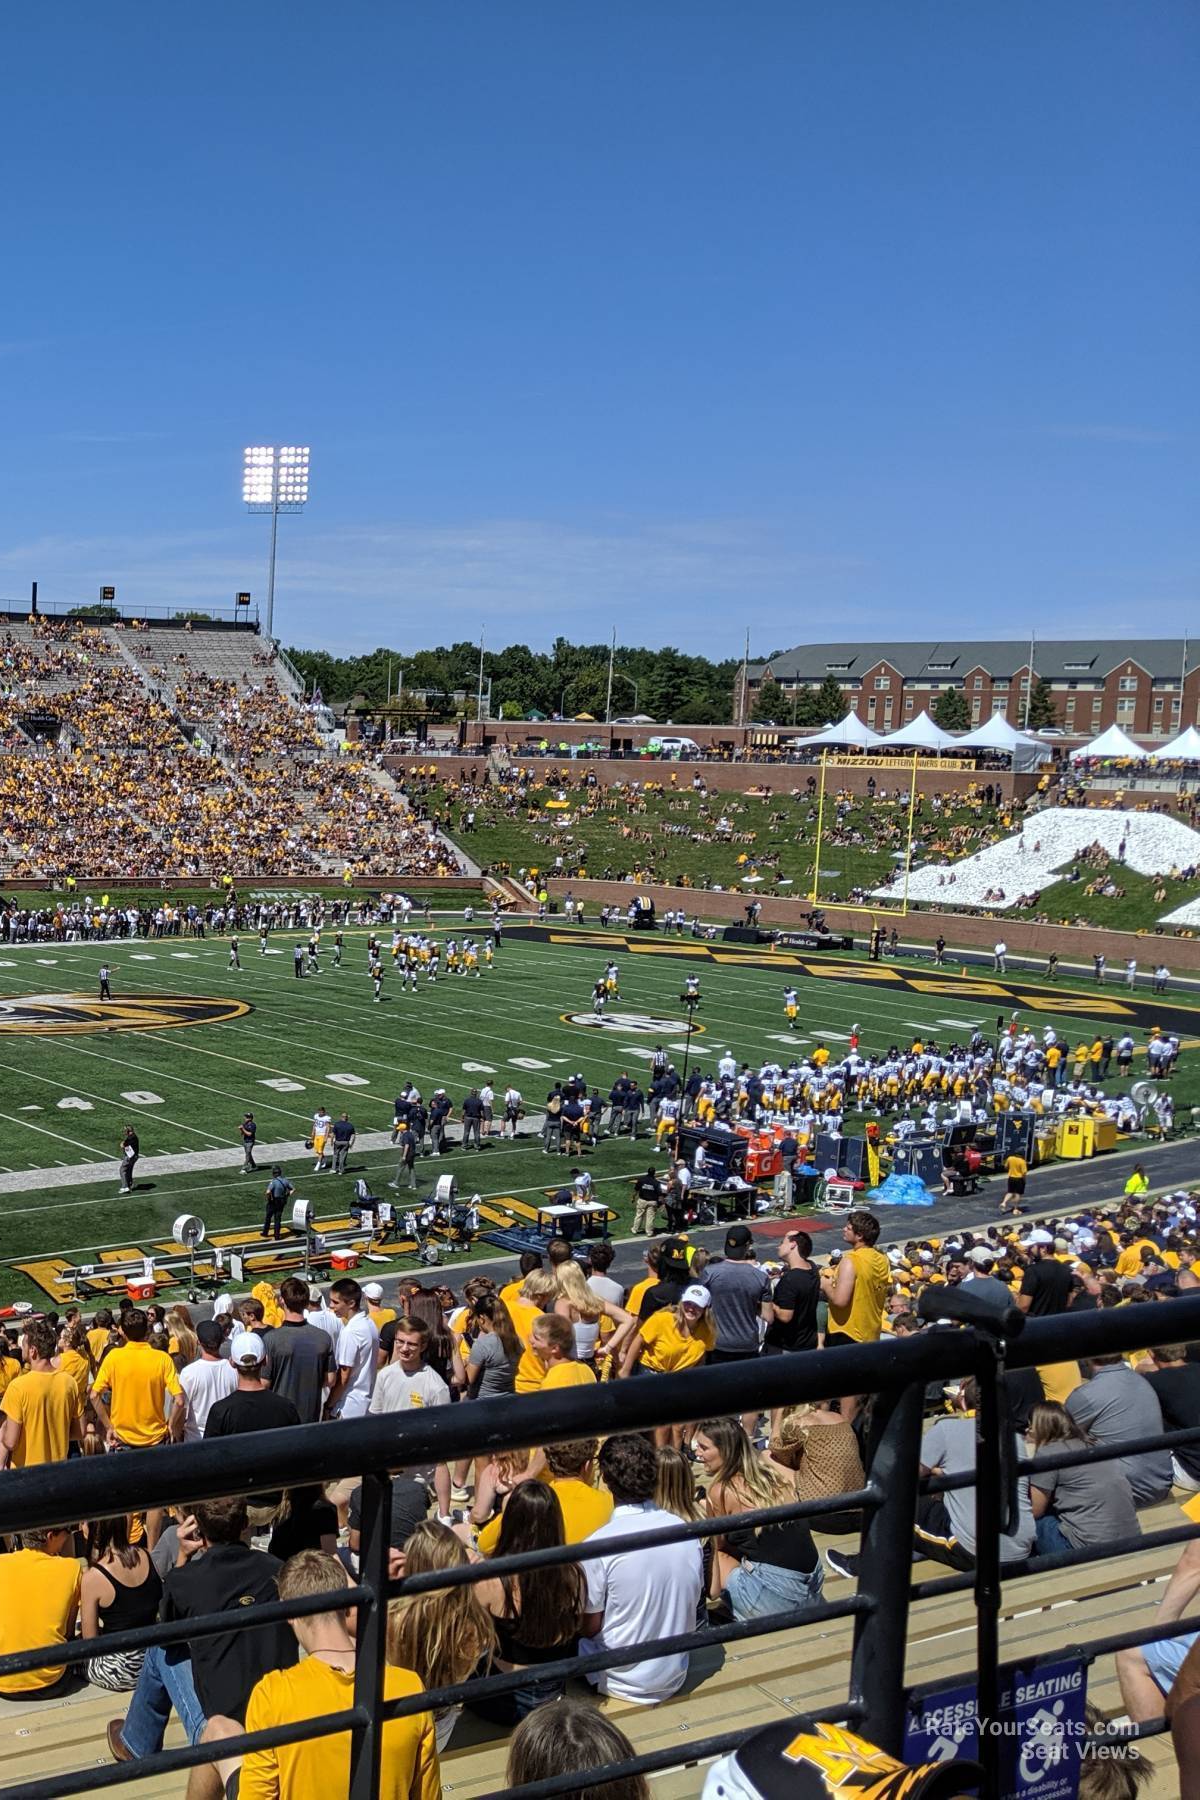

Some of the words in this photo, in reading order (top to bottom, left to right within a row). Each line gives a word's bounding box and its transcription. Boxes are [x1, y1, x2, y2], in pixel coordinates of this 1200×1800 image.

[836, 757, 883, 766] MIZZOU
[885, 759, 938, 768] LETTERWNNERS
[960, 760, 972, 770] M
[761, 1156, 772, 1171] G
[1015, 1671, 1083, 1703] SEATING
